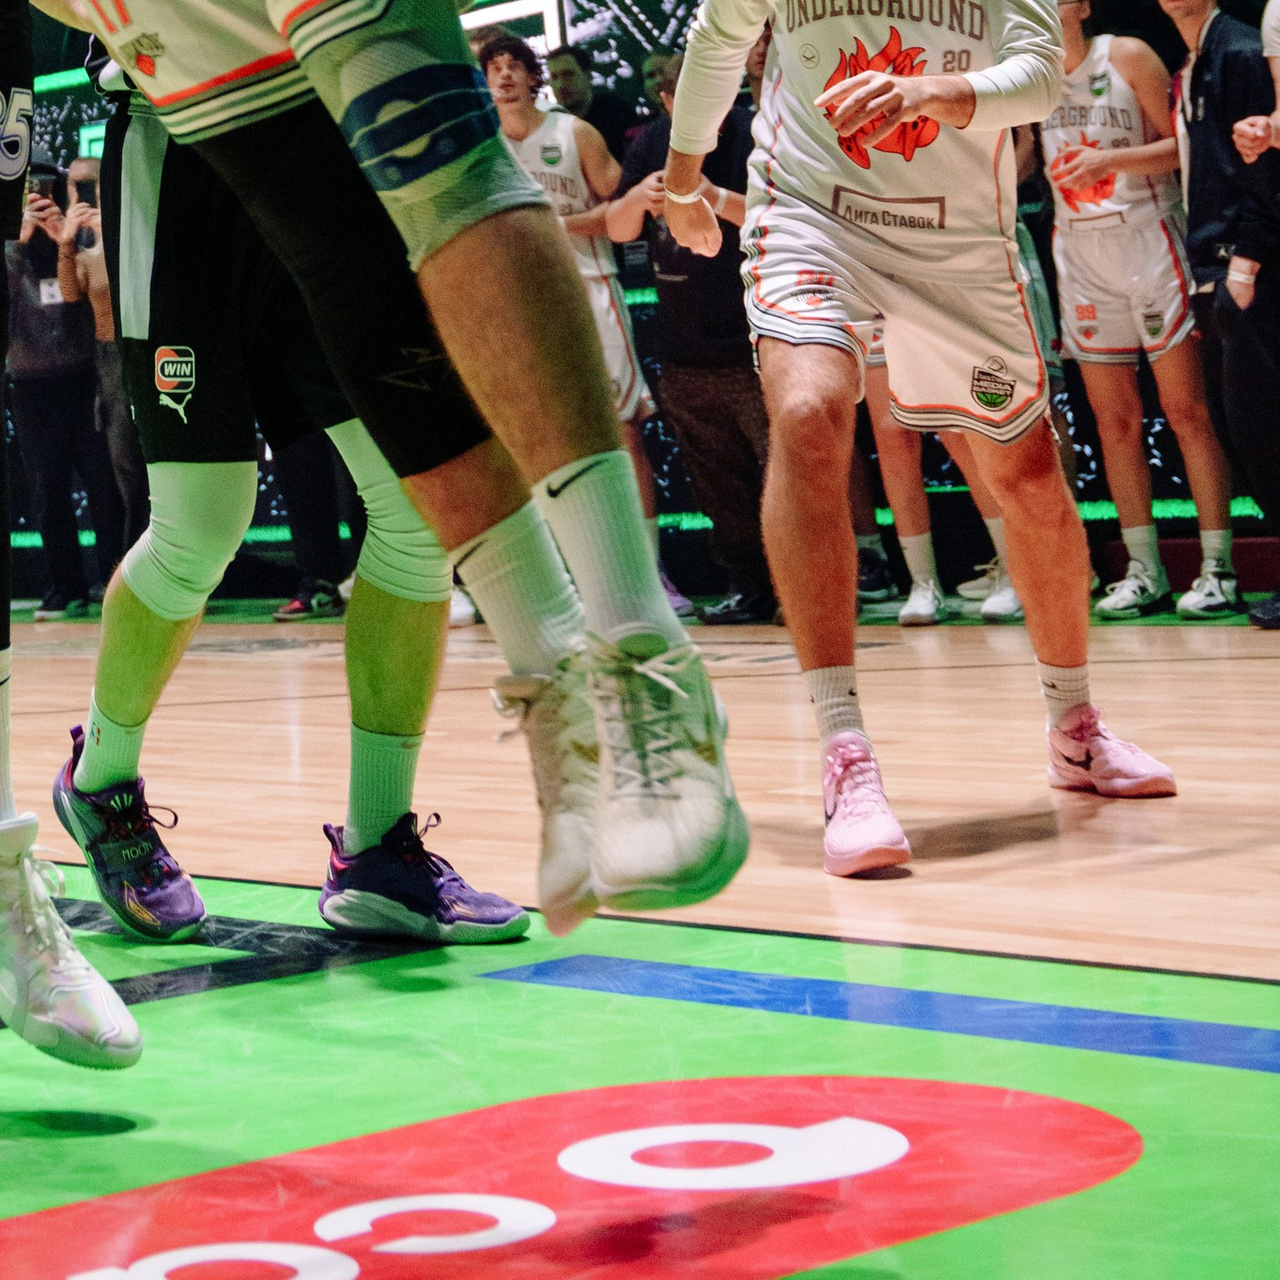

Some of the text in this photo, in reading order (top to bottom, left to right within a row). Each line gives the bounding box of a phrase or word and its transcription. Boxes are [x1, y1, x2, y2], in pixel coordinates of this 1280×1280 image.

[942, 49, 971, 73] 20
[844, 205, 937, 230] ЛИГА СТАВОК
[164, 362, 192, 376] WIN
